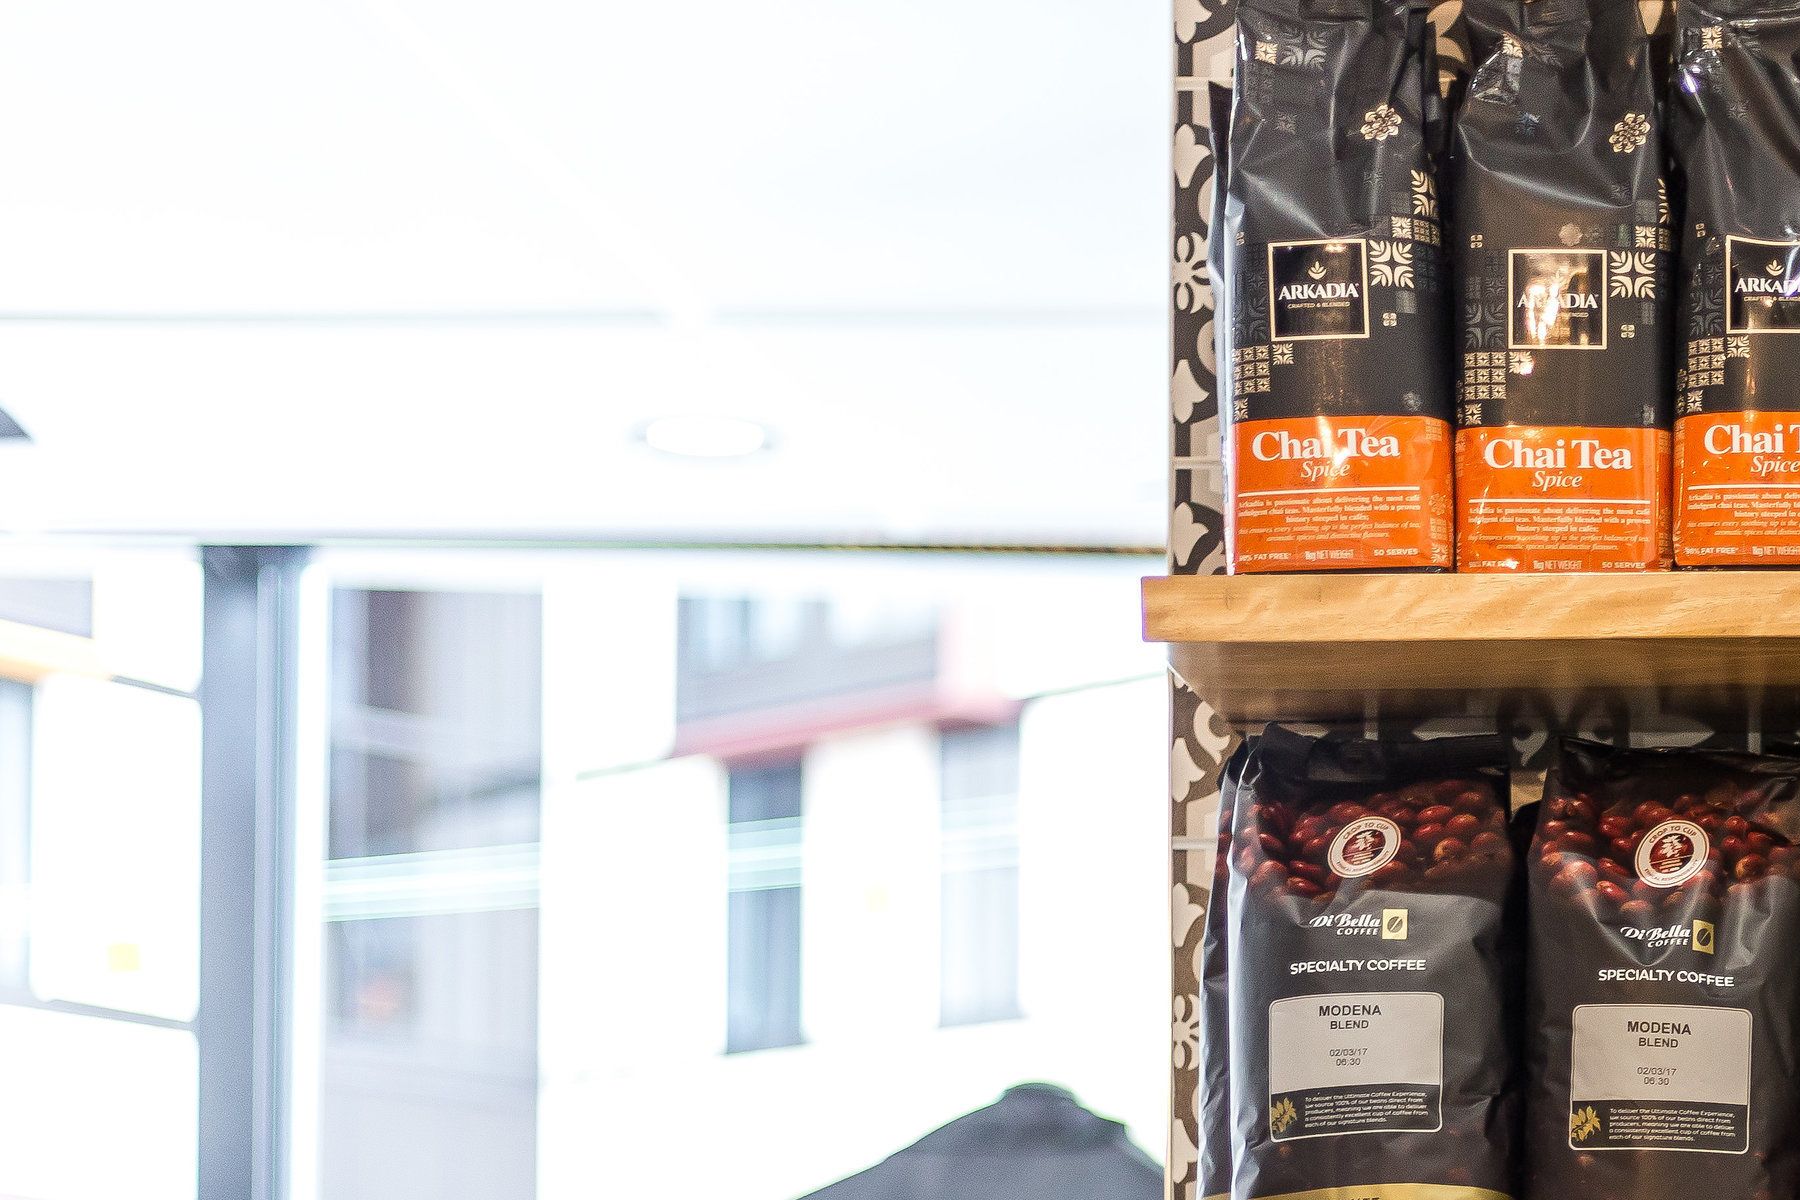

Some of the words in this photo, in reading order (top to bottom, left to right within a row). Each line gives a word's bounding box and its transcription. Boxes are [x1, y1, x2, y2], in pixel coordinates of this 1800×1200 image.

[1279, 283, 1358, 299] ARKADIA
[1252, 429, 1325, 461] Chai
[1337, 427, 1400, 457] Tea
[1703, 424, 1784, 455] Chai
[1484, 440, 1566, 469] Chai
[1570, 439, 1632, 470] Tea
[1300, 460, 1350, 479] Spice
[1750, 455, 1800, 474] Spice
[1531, 471, 1582, 489] Spice
[1336, 928, 1379, 936] COFFEE
[1647, 938, 1688, 948] COFFEE
[1290, 960, 1364, 975] SPECIALTY
[1366, 960, 1426, 971] COFFEE
[1598, 969, 1674, 982] SPECIALTY
[1676, 970, 1734, 987] COFFEE
[1319, 1005, 1382, 1017] MODENA
[1330, 1020, 1369, 1030] BLEND
[1627, 1021, 1691, 1035] MODENA
[1638, 1037, 1679, 1048] BLEND
[1329, 1048, 1367, 1057] 02/03/17
[1637, 1066, 1676, 1076] 02/03/17
